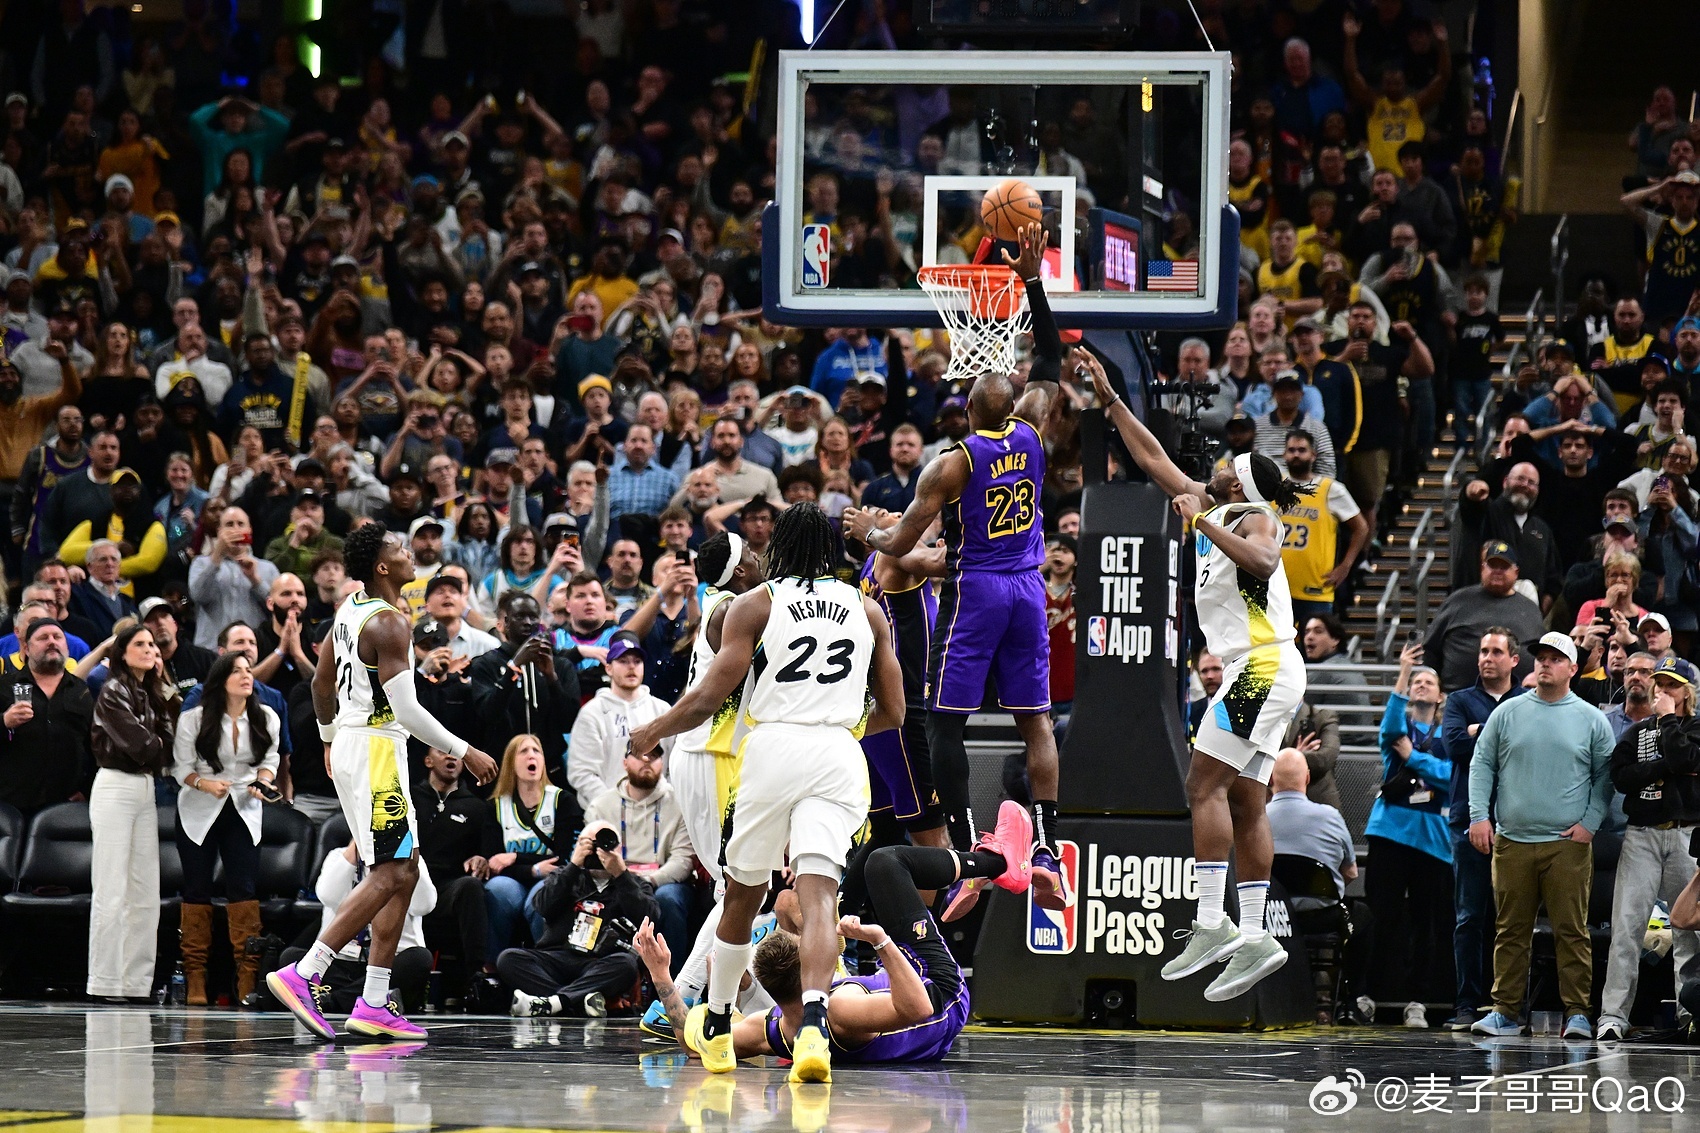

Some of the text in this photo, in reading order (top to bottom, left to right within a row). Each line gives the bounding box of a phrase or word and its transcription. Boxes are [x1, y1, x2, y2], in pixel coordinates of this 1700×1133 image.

[990, 453, 1027, 479] JAMES
[986, 479, 1035, 539] 23
[1101, 536, 1144, 573] GET
[1282, 523, 1309, 549] 23
[787, 600, 850, 625] NESMITH
[1100, 576, 1143, 613] THE
[1107, 617, 1152, 663] App
[775, 636, 855, 684] 23
[1087, 843, 1199, 909] League
[1034, 927, 1058, 947] NBA
[1085, 900, 1165, 955] Pass
